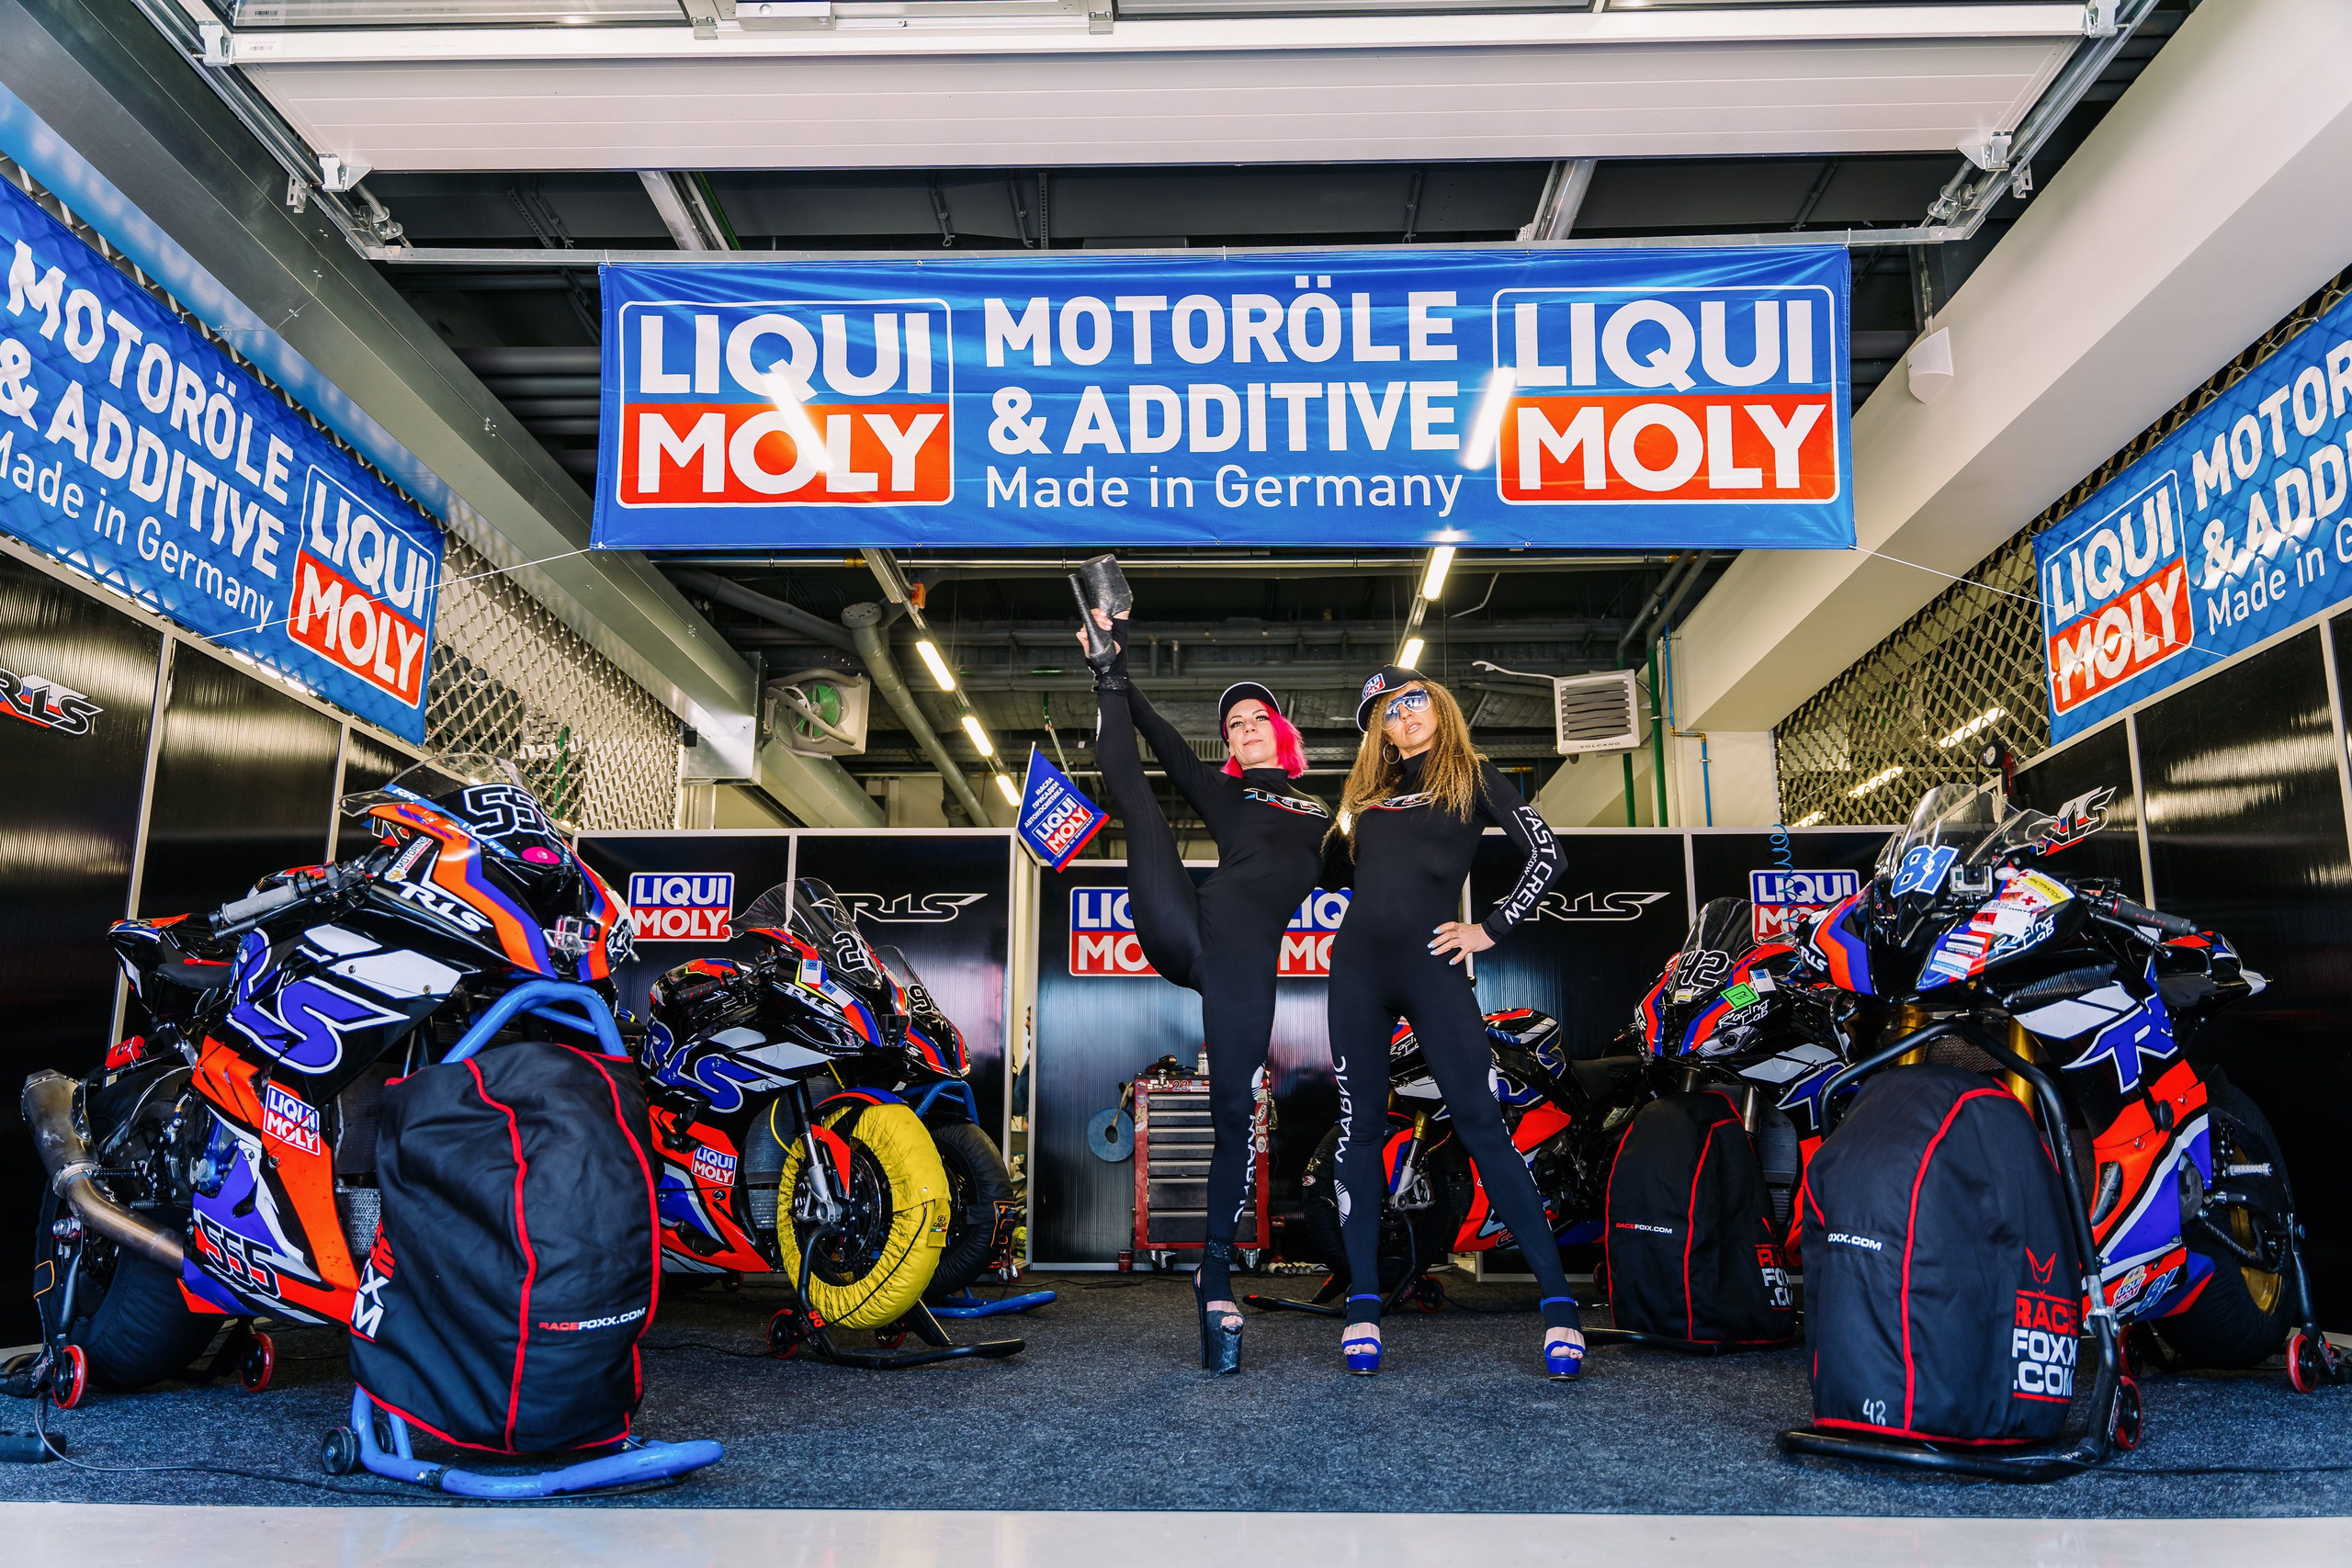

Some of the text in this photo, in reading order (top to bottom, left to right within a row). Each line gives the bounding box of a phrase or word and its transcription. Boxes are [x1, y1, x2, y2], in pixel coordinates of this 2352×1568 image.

[985, 275, 1457, 367] MOTORÖLE
[640, 313, 932, 402] LIQUI
[1515, 299, 1813, 392] LIQUI
[7, 239, 293, 507] MOTORÖLE
[988, 381, 1459, 455] & ADDITIVE
[0, 338, 285, 579] & ADDITIVE
[639, 411, 944, 494] MOLY
[1517, 403, 1826, 491] MOLY
[987, 466, 1463, 517] Made in Germany
[93, 488, 124, 545] in
[139, 515, 274, 634] Germany
[308, 480, 428, 620] LIQUI
[2051, 486, 2177, 626] LIQUI
[2204, 520, 2233, 590] &
[2208, 570, 2285, 635] Made
[2296, 545, 2325, 589] in
[298, 567, 424, 694] MOLY
[2057, 567, 2184, 702] MOLY
[391, 787, 422, 801] RR
[1024, 787, 1065, 829] АВТОКОСМЕТИКА
[1032, 781, 1060, 809] ПРИСАДКИ
[1035, 777, 1054, 795] МАСЛА
[1035, 796, 1078, 840] LIQUI
[1047, 807, 1087, 852] MOLY
[1057, 845, 1070, 858] MADE
[1075, 817, 1095, 840] GERMANY
[1519, 806, 1556, 860] FAST
[396, 837, 429, 870] MOTORING
[1890, 844, 1960, 898] 81
[637, 877, 727, 907] LIQUI
[1504, 862, 1553, 925] CREW
[1758, 874, 1851, 905] LIQUI
[636, 908, 728, 937] MOLY
[2133, 931, 2154, 947] YAMAHA
[1679, 950, 1730, 989] 42
[1172, 1079, 1190, 1092] 23
[266, 1111, 317, 1150] MOLY
[269, 1089, 319, 1131] LIQUI
[694, 1161, 733, 1184] MOLY
[696, 1148, 736, 1171] LIQUI
[1615, 1223, 1673, 1235] RACEFOXX.COM
[198, 1210, 282, 1299] 555
[2015, 1296, 2078, 1336] RACE
[2115, 1287, 2139, 1306] MOLY
[538, 1307, 647, 1331] RACEFOXX.COM
[2012, 1328, 2078, 1367] FOXX
